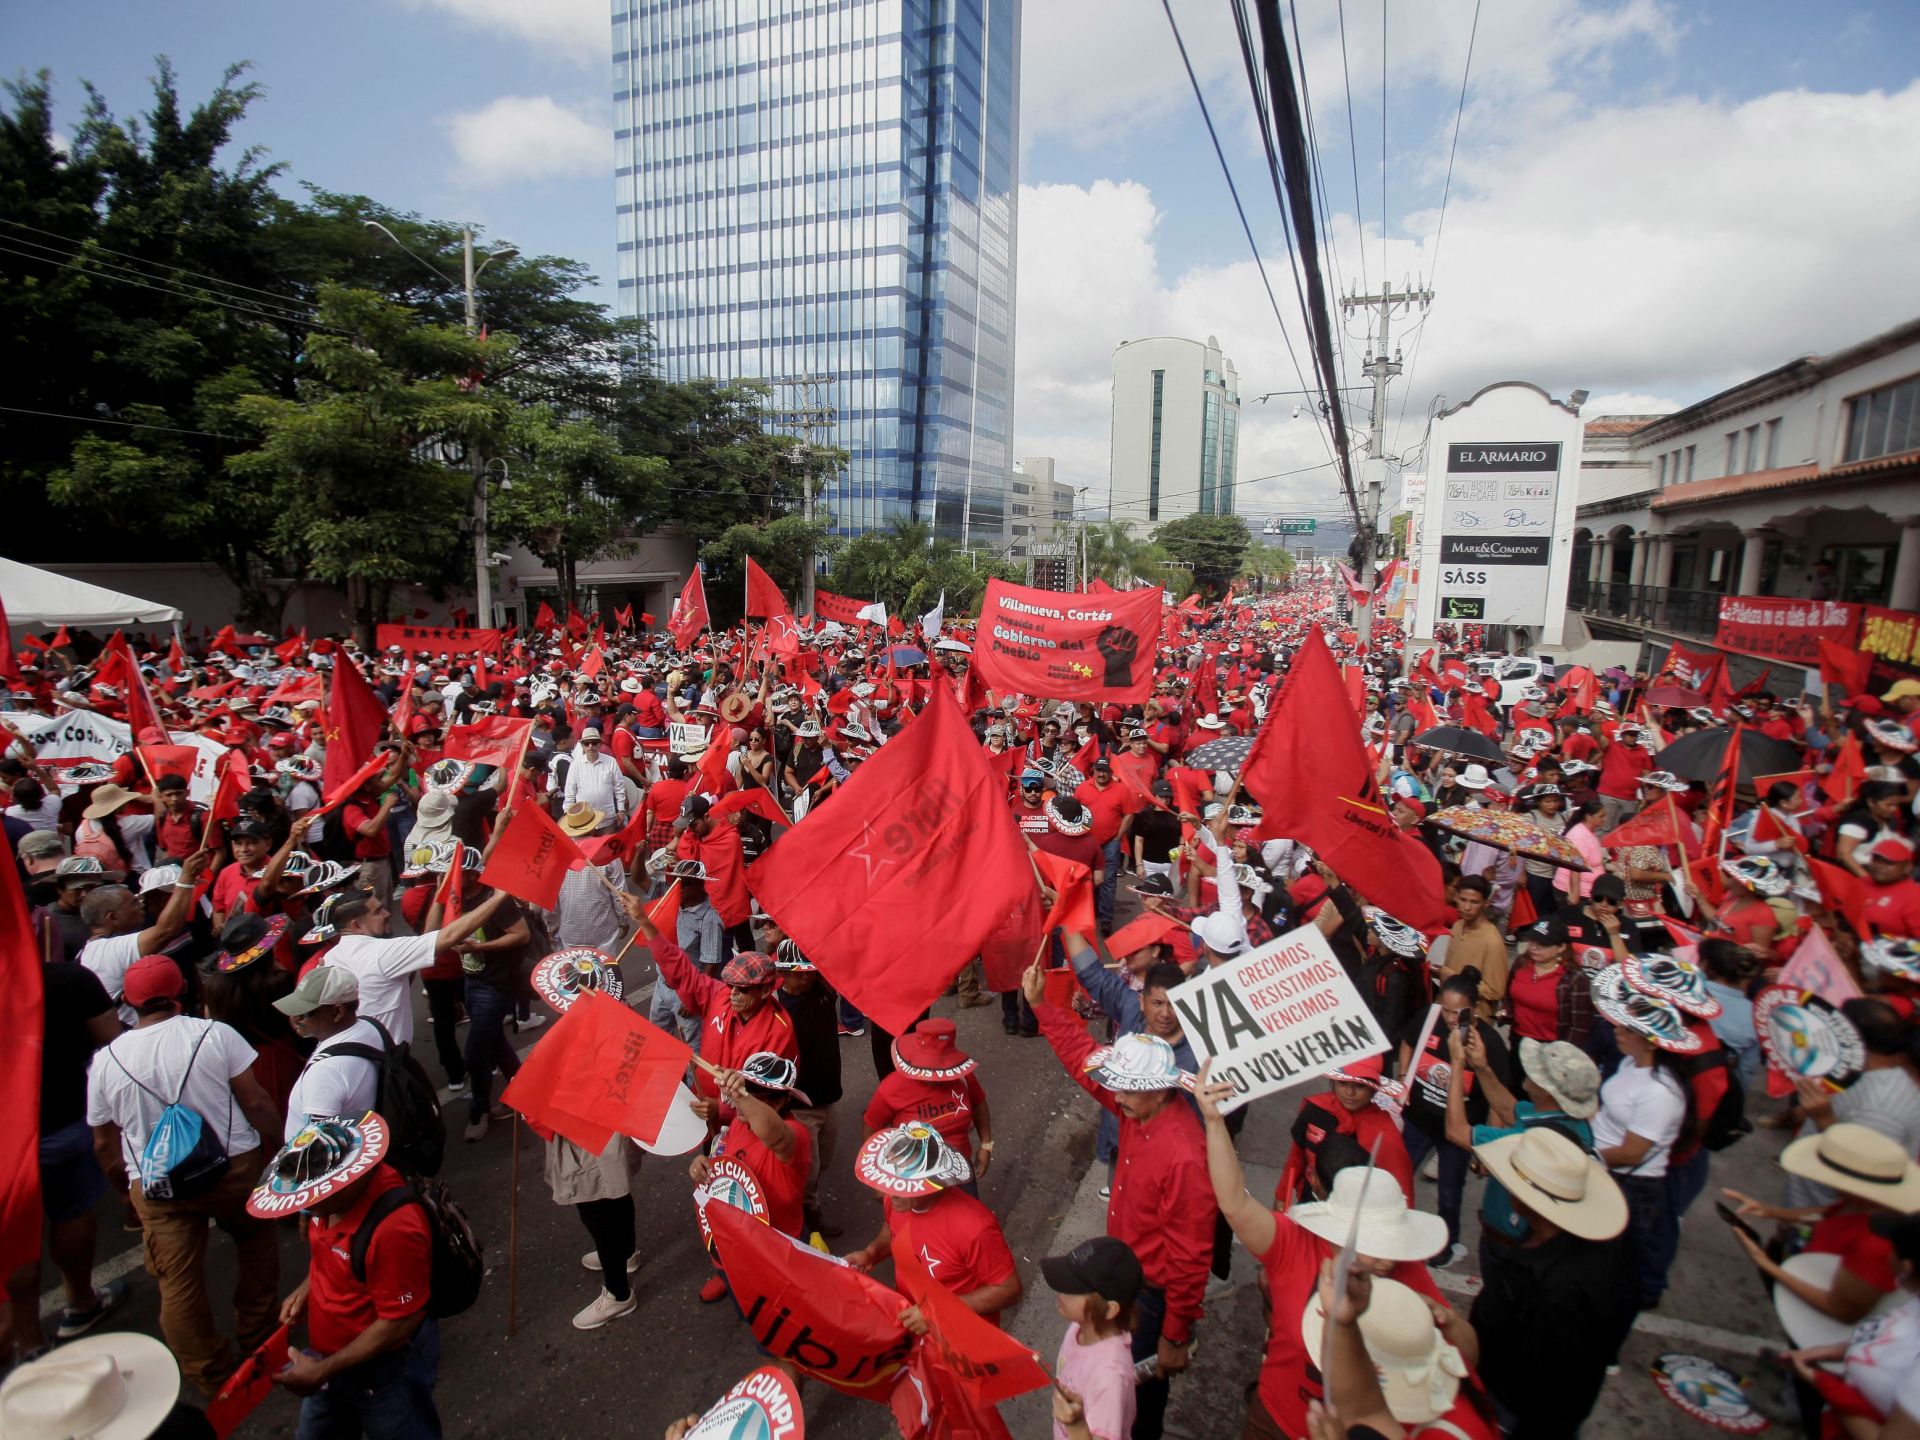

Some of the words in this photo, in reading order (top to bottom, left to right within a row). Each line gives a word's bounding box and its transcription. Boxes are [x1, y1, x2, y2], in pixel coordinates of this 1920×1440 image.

[1459, 452, 1476, 462] EL
[1478, 451, 1547, 464] ARMARIO
[1503, 508, 1546, 527] Blu
[999, 596, 1065, 621] Villanueva,
[1067, 606, 1113, 622] Cortés
[993, 624, 1057, 649] Gobierno
[1060, 639, 1086, 650] del
[992, 639, 1041, 662] Pueblo
[671, 725, 686, 742] YA
[1344, 809, 1379, 834] Libertad
[1248, 959, 1344, 1011] RESISTIMOS,
[1174, 978, 1266, 1057] YA
[1237, 942, 1316, 988] CRECIMOS,
[1260, 988, 1340, 1034] VENCIMOS
[1244, 1014, 1376, 1084] VOLVERÁN
[916, 1099, 957, 1121] libre
[335, 1118, 384, 1184] XIOMARA
[725, 1161, 764, 1215] CUMPLE
[860, 1163, 926, 1193] XIOMARA
